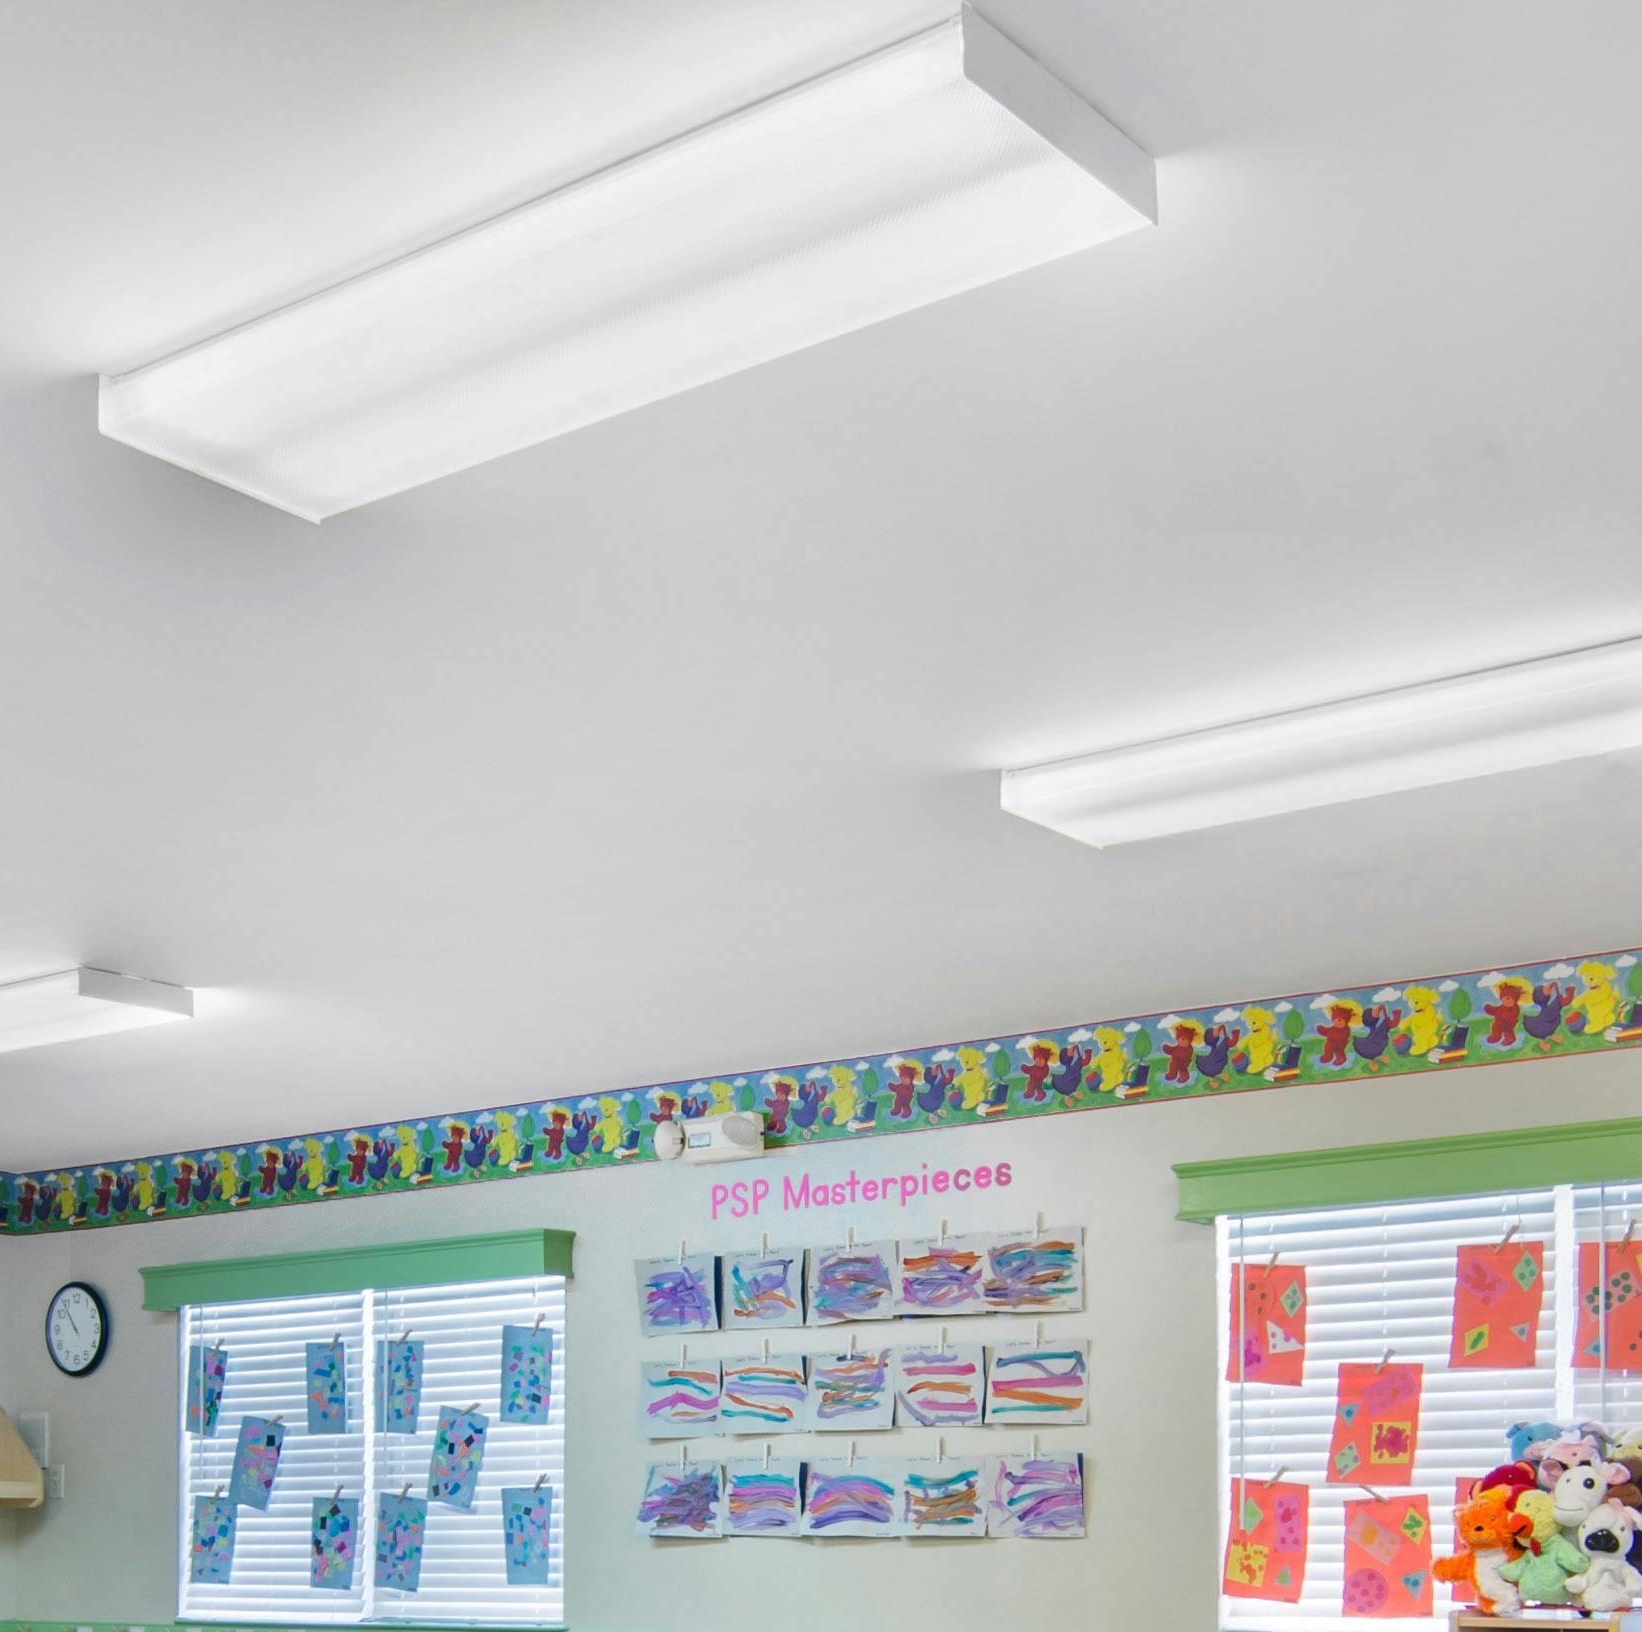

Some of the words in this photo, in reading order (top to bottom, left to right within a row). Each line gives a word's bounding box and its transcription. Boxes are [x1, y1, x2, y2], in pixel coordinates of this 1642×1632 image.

[710, 1177, 771, 1220] PSP
[783, 1162, 1013, 1211] Masterpieces
[72, 1293, 81, 1305] 12
[57, 1309, 66, 1320] 10
[90, 1308, 97, 1319] 2
[54, 1325, 61, 1335] 9
[93, 1324, 100, 1334] 3
[56, 1340, 63, 1350] 8
[90, 1340, 97, 1349] 4
[64, 1350, 71, 1361] 7
[73, 1354, 80, 1366] 6
[83, 1351, 89, 1361] 5
